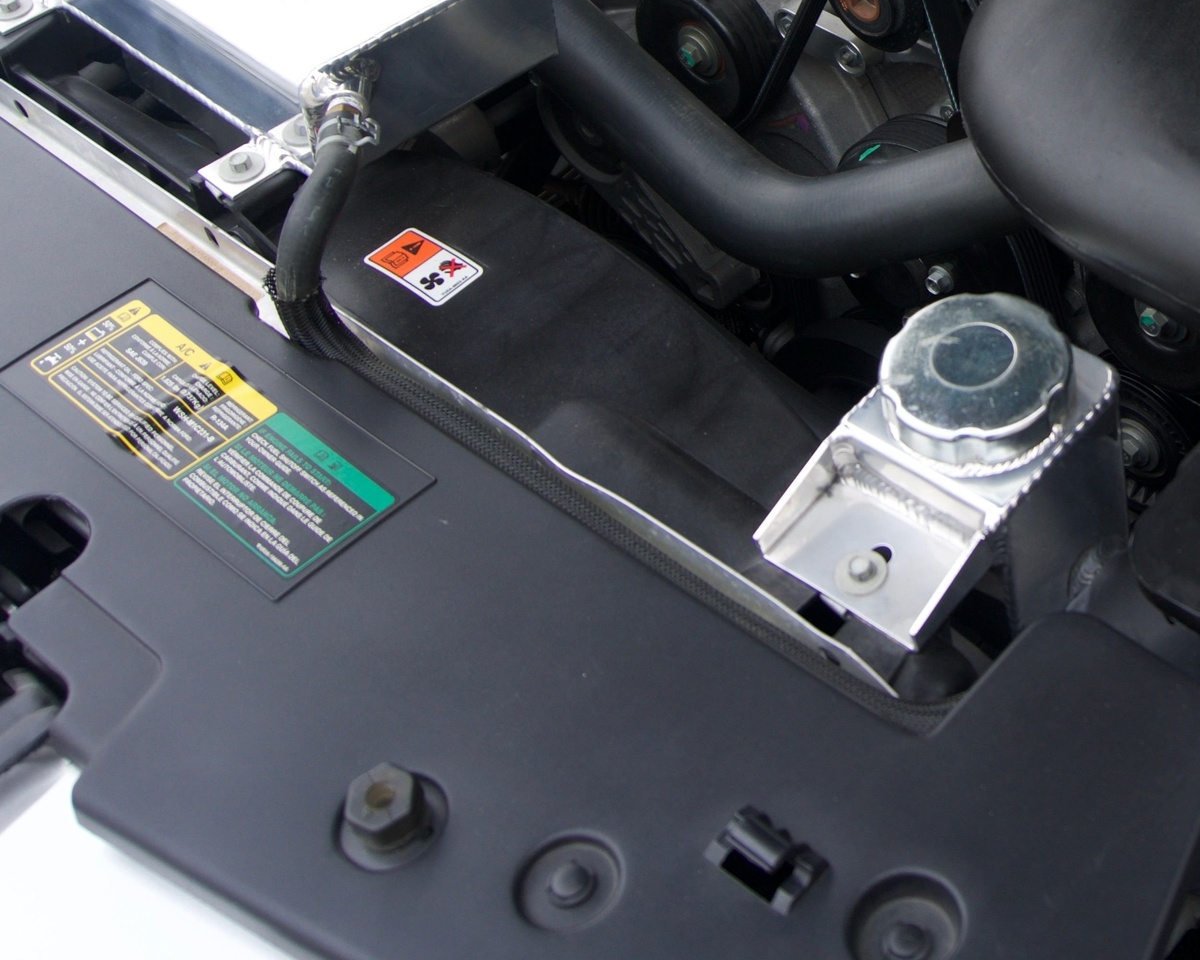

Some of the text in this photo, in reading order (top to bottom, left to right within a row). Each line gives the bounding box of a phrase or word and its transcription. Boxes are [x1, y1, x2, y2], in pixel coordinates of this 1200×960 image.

[103, 319, 115, 331] 50%
[64, 342, 77, 354] 50%
[126, 346, 137, 357] SAE
[176, 343, 195, 357] A/C
[241, 448, 250, 457] LE
[249, 454, 273, 475] MOTEUR
[273, 472, 282, 482] NE
[245, 436, 259, 449] YOUR
[258, 446, 276, 463] OWNER
[251, 431, 268, 447] CHECK
[268, 443, 280, 456] FUEL
[279, 453, 301, 473] SHUTOFF
[300, 469, 318, 486] SWITCH
[318, 483, 326, 492] AS
[286, 448, 302, 464] FAILS
[302, 461, 311, 471] TO
[189, 471, 223, 502] COMBUSTIBLE
[222, 498, 238, 514] COMO
[196, 467, 214, 484] REVISE
[213, 481, 221, 490] EL
[219, 486, 253, 517] INTERRUPTOR
[253, 513, 261, 523] DE
[210, 467, 218, 477] EL
[218, 474, 239, 494] MOTOR
[239, 491, 248, 501] NO
[248, 463, 256, 472] LA
[255, 468, 282, 494] COMMANDE
[282, 490, 290, 500] DE
[249, 474, 268, 492] COMME
[287, 504, 301, 519] DANS
[300, 515, 308, 524] LE
[307, 520, 323, 537] GUIDE
[323, 532, 332, 544] DE
